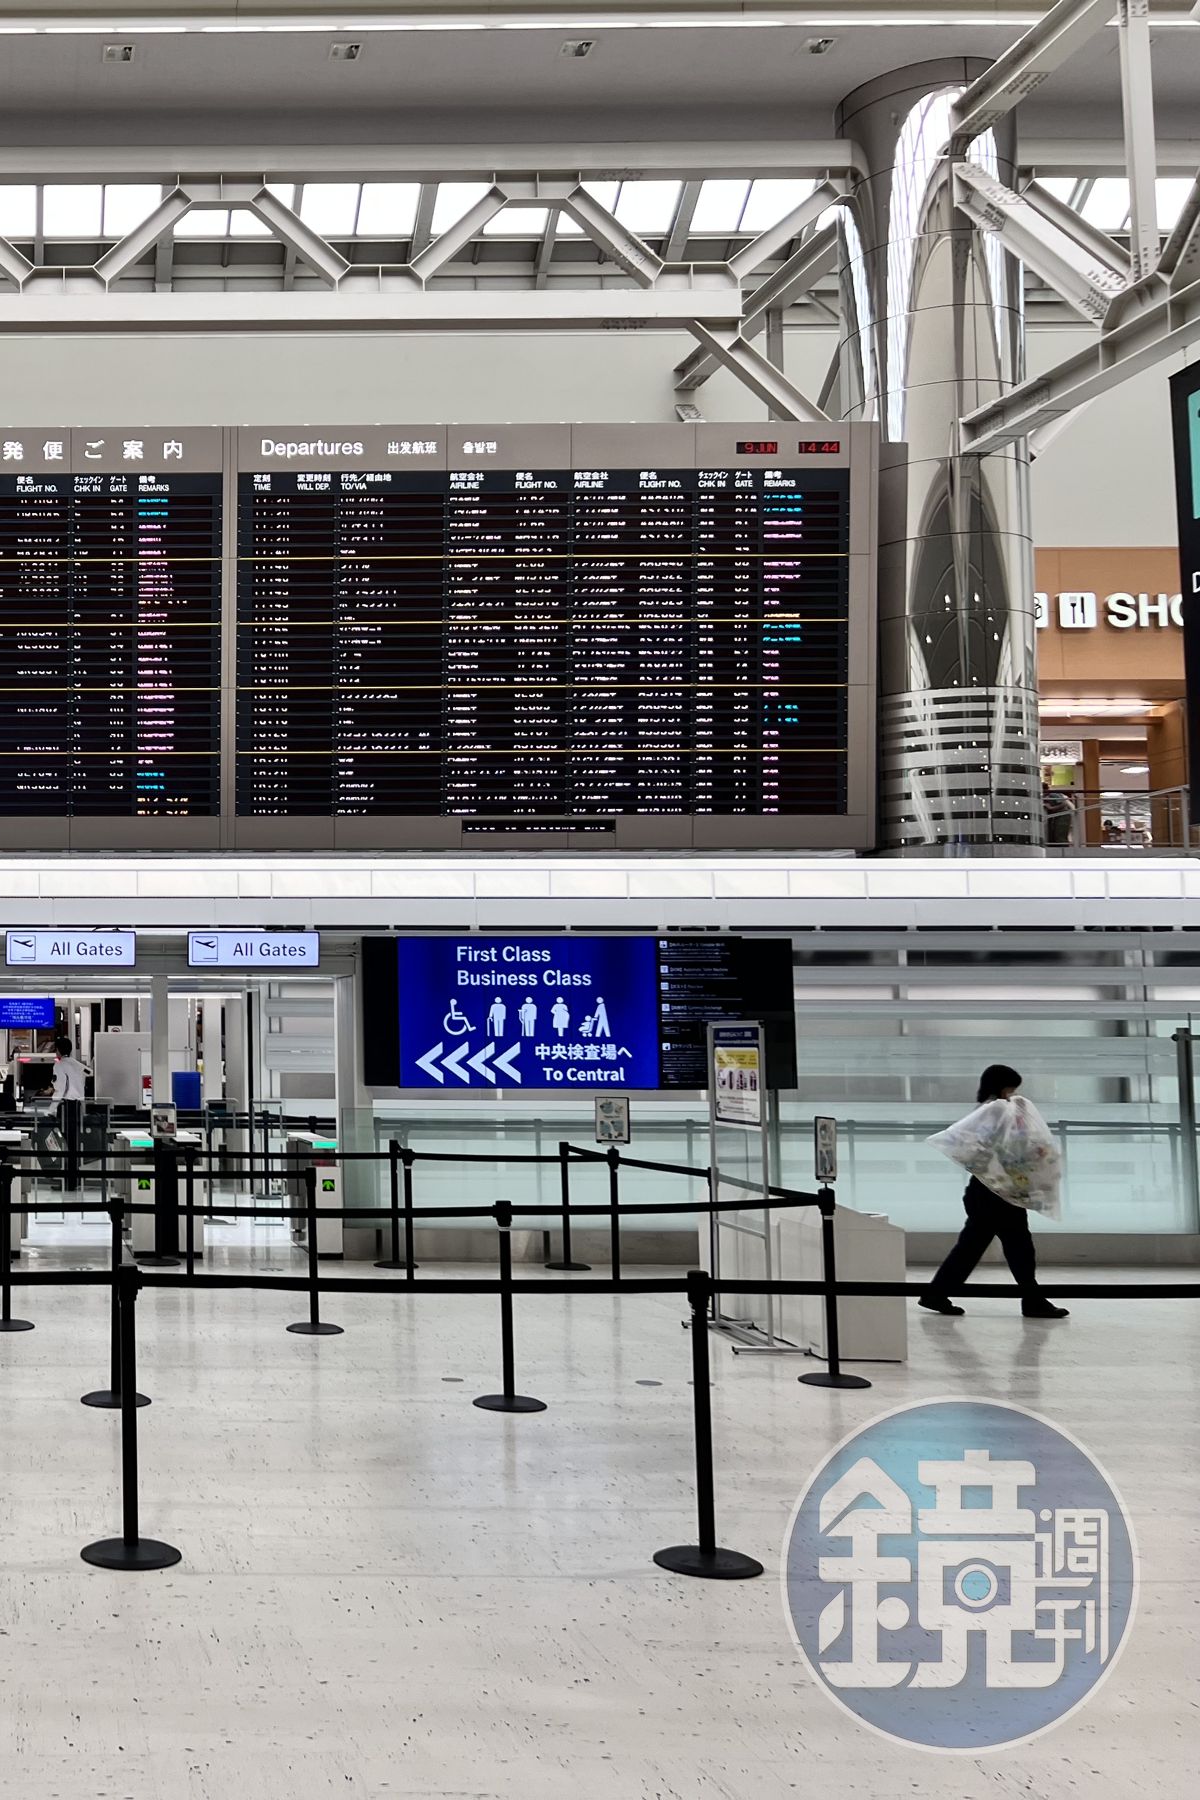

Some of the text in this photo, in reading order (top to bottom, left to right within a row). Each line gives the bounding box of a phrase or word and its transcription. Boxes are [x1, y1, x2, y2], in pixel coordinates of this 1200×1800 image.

[261, 439, 364, 458] Departures
[744, 443, 753, 453] 9
[16, 484, 58, 492] FLIGHT NO.
[74, 484, 100, 492] CHK IN
[110, 484, 127, 492] GATE
[138, 484, 169, 492] REMARKS
[253, 483, 271, 491] TIME
[515, 481, 557, 489] FLIGHT NO.
[639, 480, 682, 488] FLIGHT NO.
[698, 480, 726, 488] CHK IN
[735, 480, 753, 488] GATE
[50, 941, 123, 956] All Gates
[233, 942, 306, 956] All Gates
[456, 946, 551, 962] First Class
[457, 970, 592, 986] Business Class
[535, 1043, 633, 1061] 中央検査場へ
[542, 1067, 626, 1082] To Central
